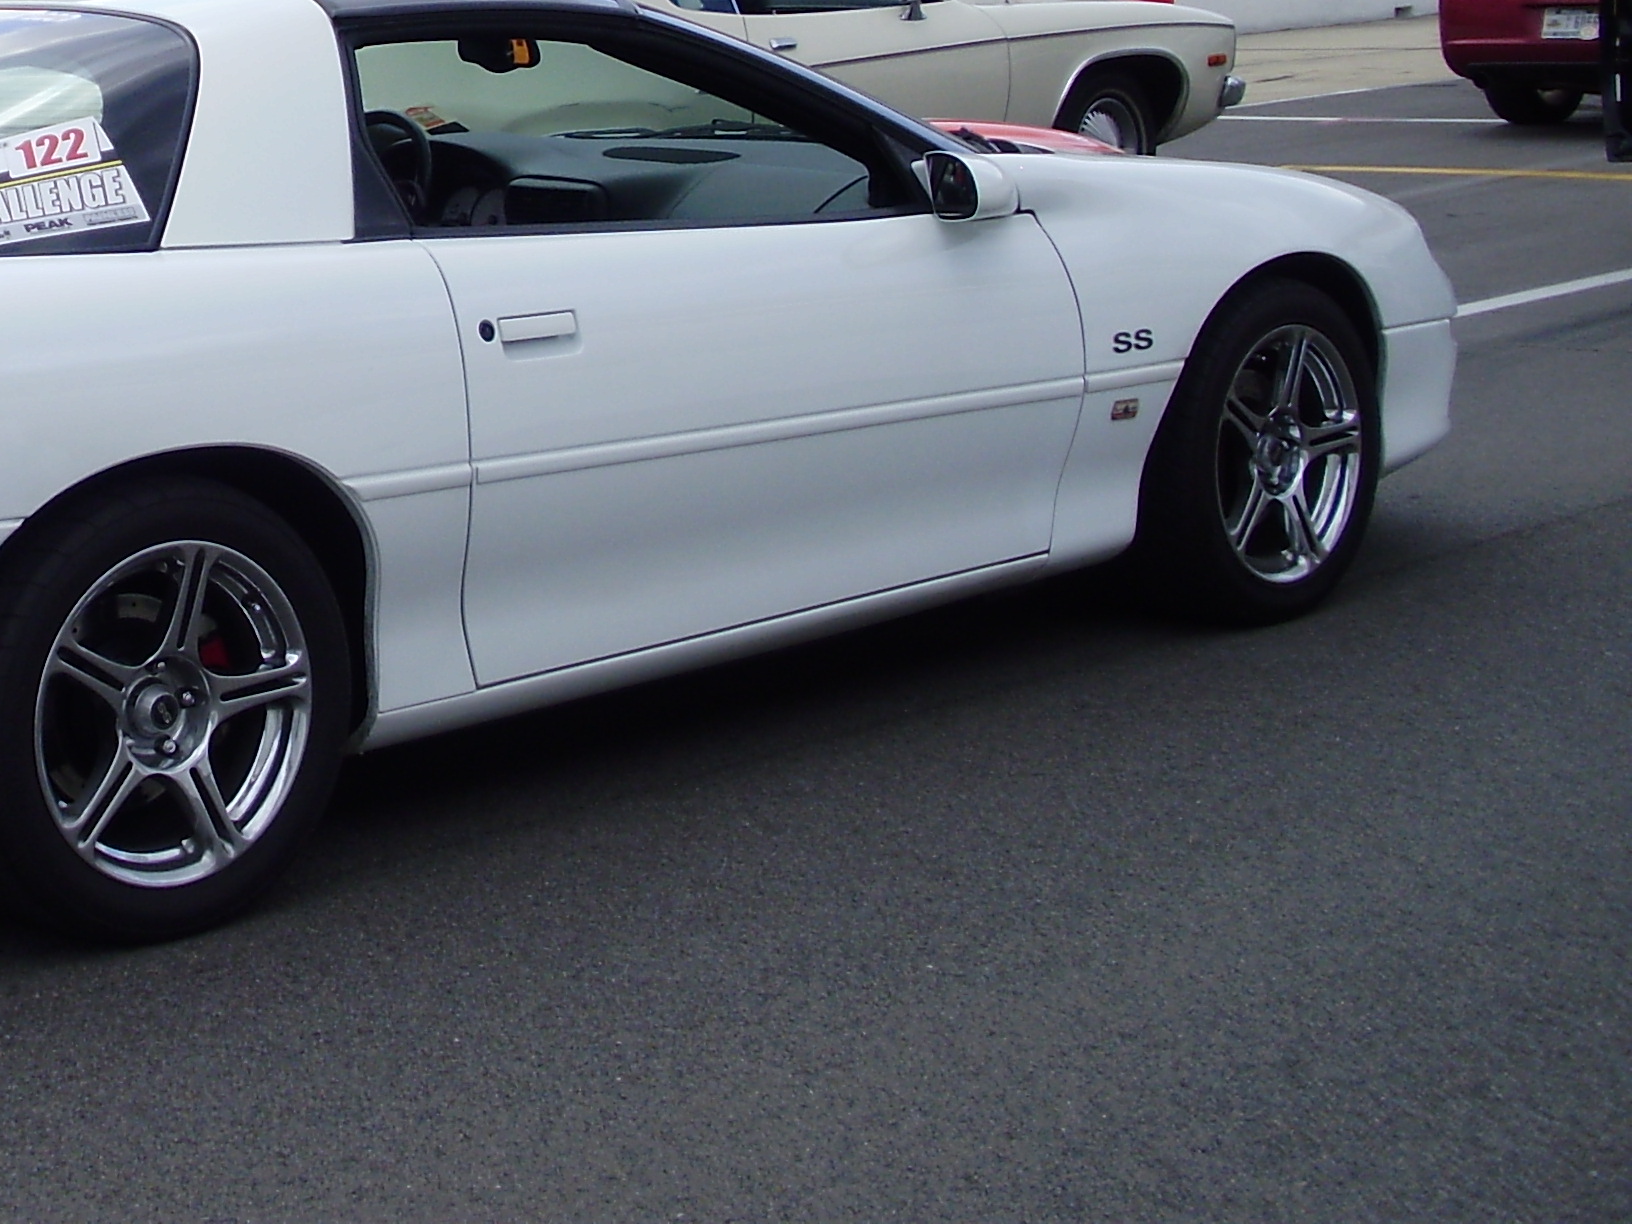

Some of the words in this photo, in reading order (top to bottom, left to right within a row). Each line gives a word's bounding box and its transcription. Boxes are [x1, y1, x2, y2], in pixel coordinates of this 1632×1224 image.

[14, 127, 90, 171] 122
[23, 217, 73, 233] PEAK
[1112, 328, 1154, 354] SS
